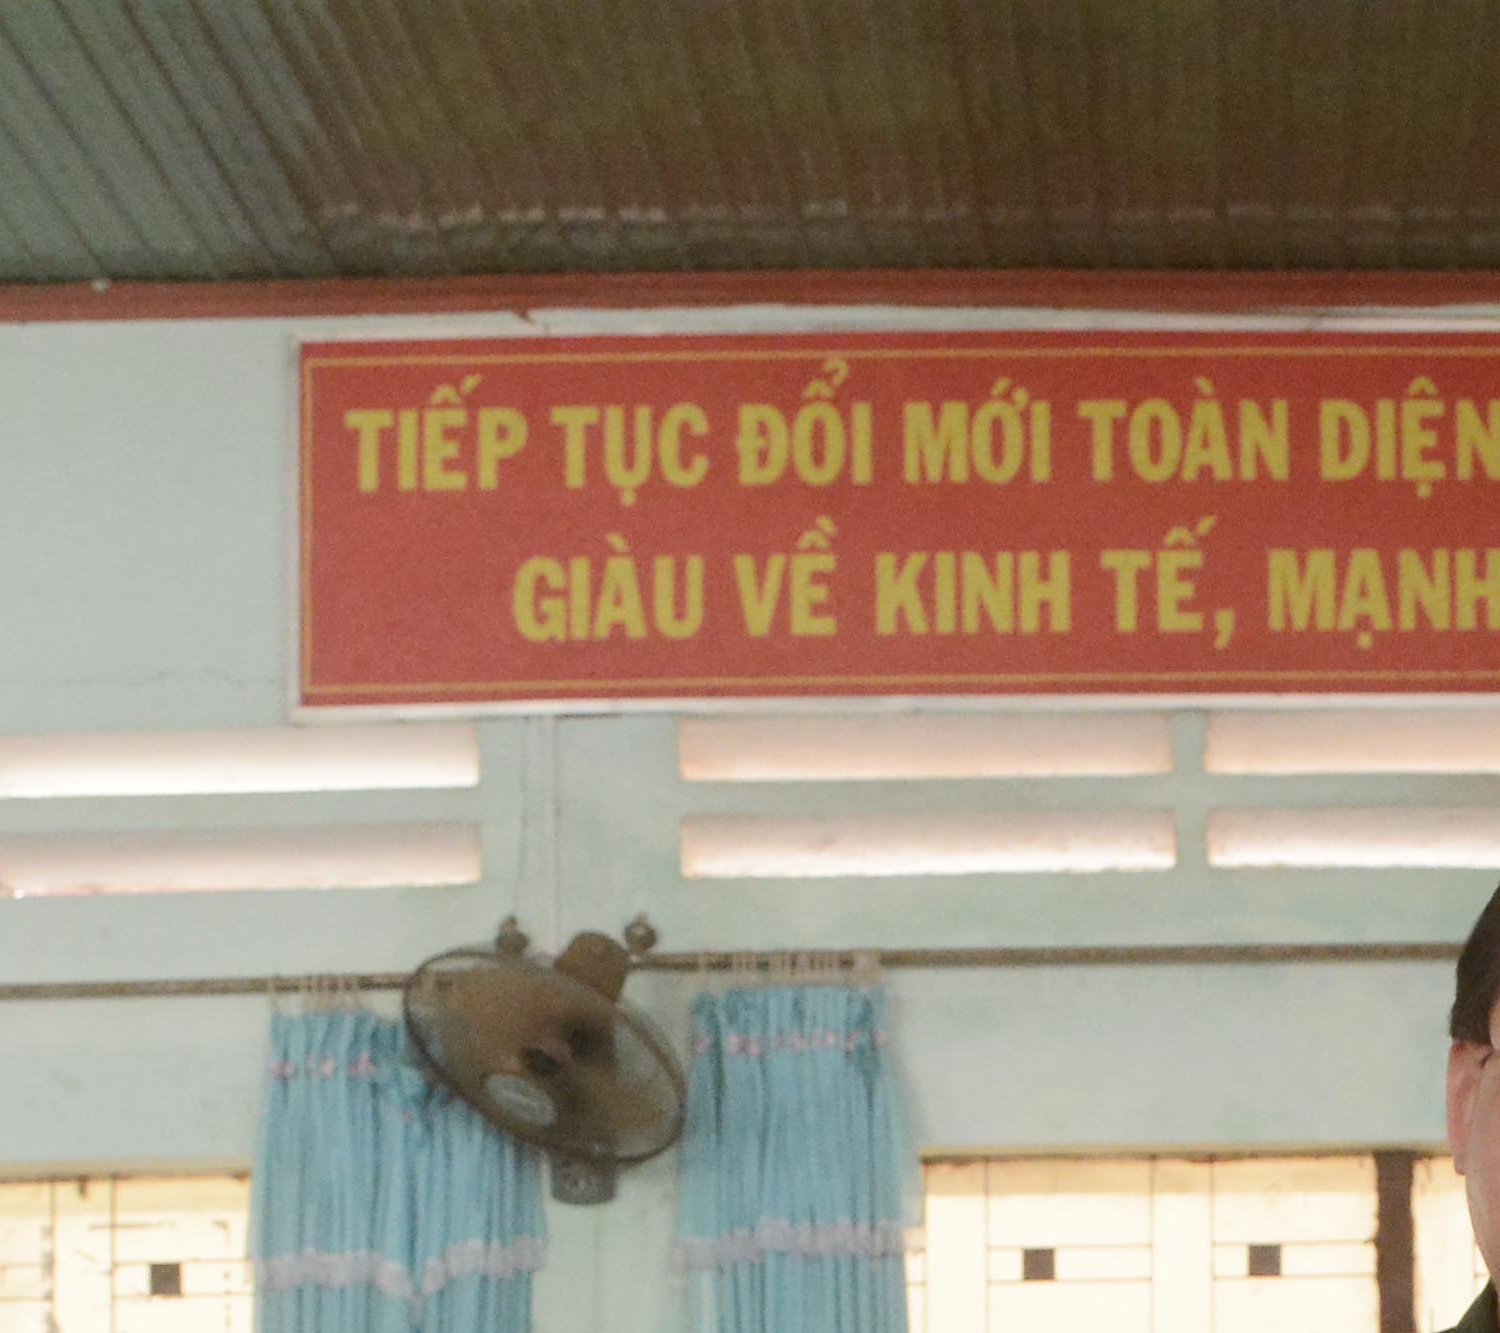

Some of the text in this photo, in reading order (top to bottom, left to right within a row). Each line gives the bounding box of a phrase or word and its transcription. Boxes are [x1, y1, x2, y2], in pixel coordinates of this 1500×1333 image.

[342, 372, 531, 494] TIẾP
[549, 402, 714, 507] TỤC
[733, 358, 875, 489] ĐỔI
[900, 376, 1054, 487] MỚI
[1076, 375, 1291, 485] TOÀN
[509, 530, 707, 644] GIÀU
[730, 514, 840, 640] VỀ
[872, 547, 1075, 639] KINH
[1098, 514, 1238, 651] TẾ,
